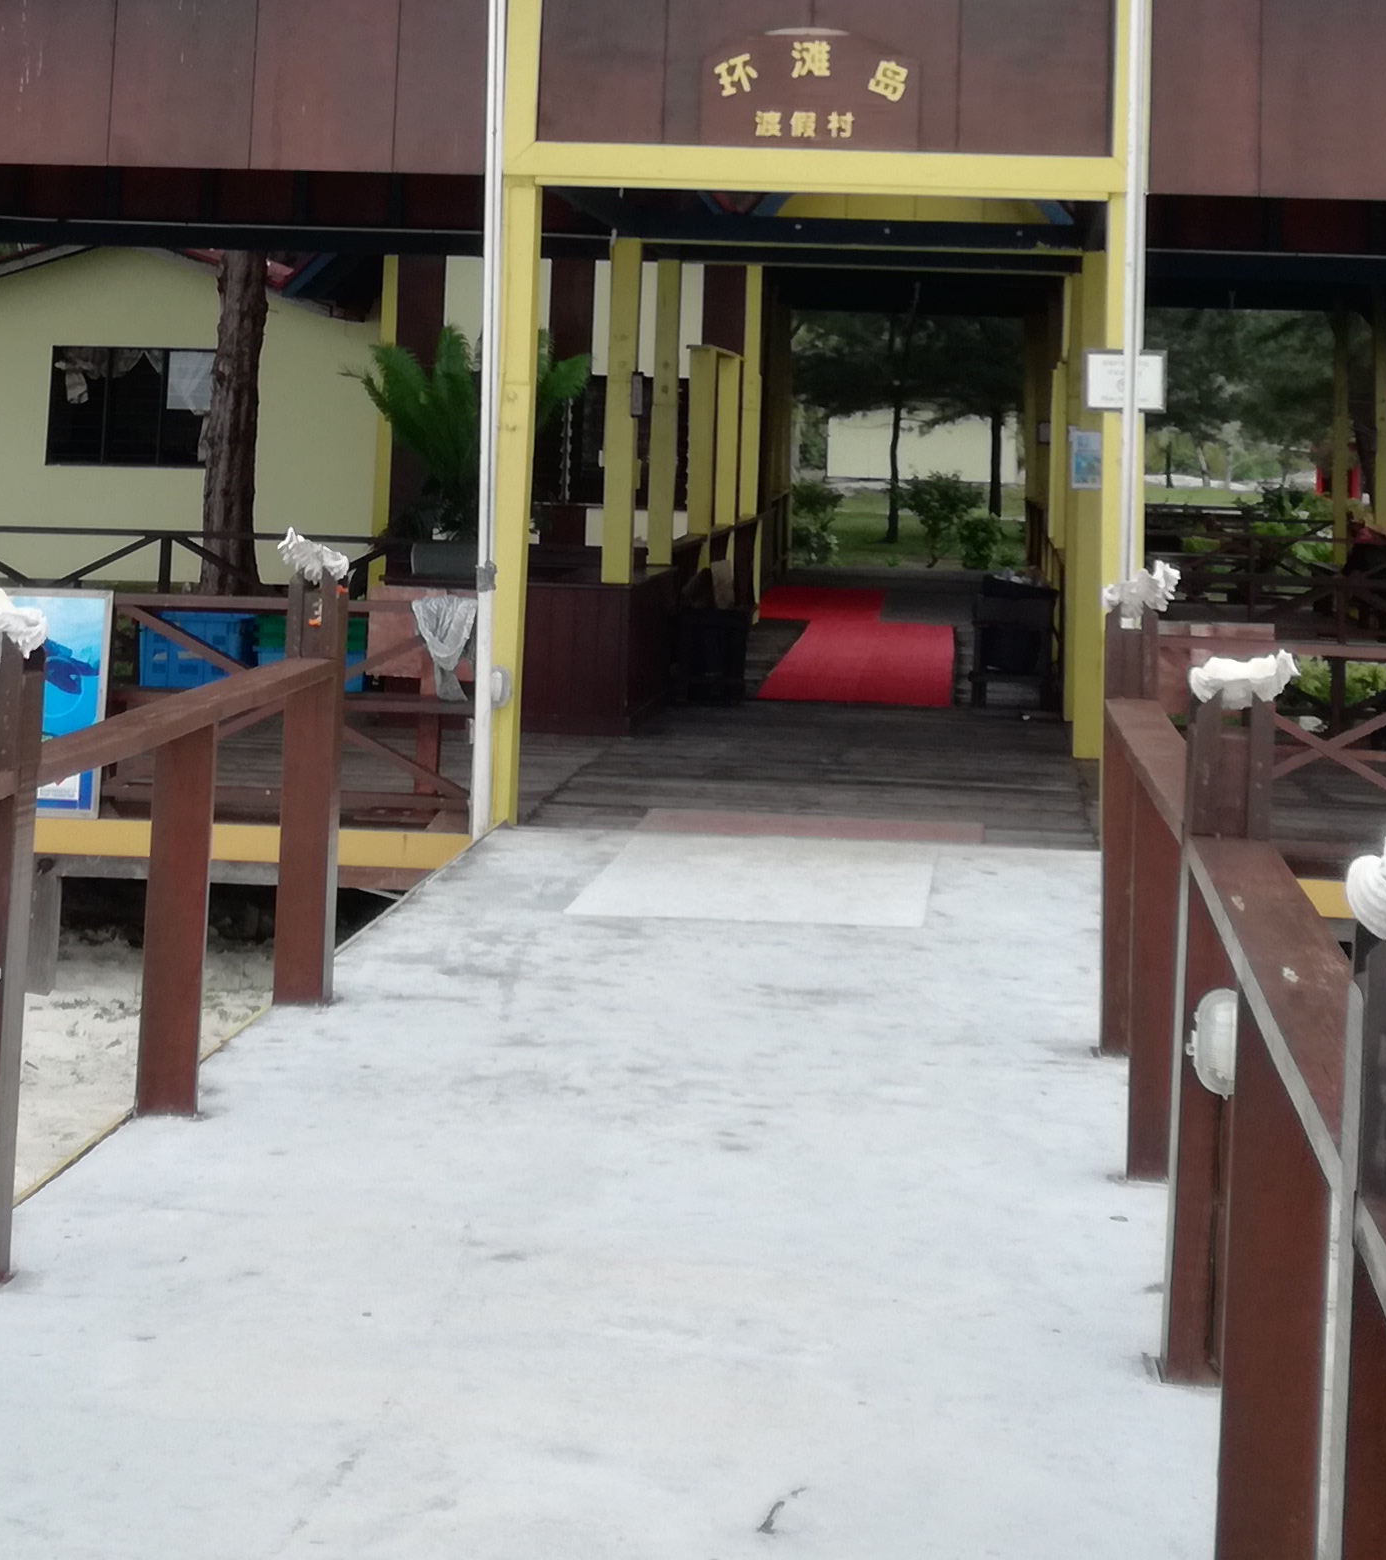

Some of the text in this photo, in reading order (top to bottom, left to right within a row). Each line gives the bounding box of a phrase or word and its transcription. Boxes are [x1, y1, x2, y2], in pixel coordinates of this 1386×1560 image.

[714, 40, 909, 102] 环滩岛
[755, 111, 855, 138] 渡假村
